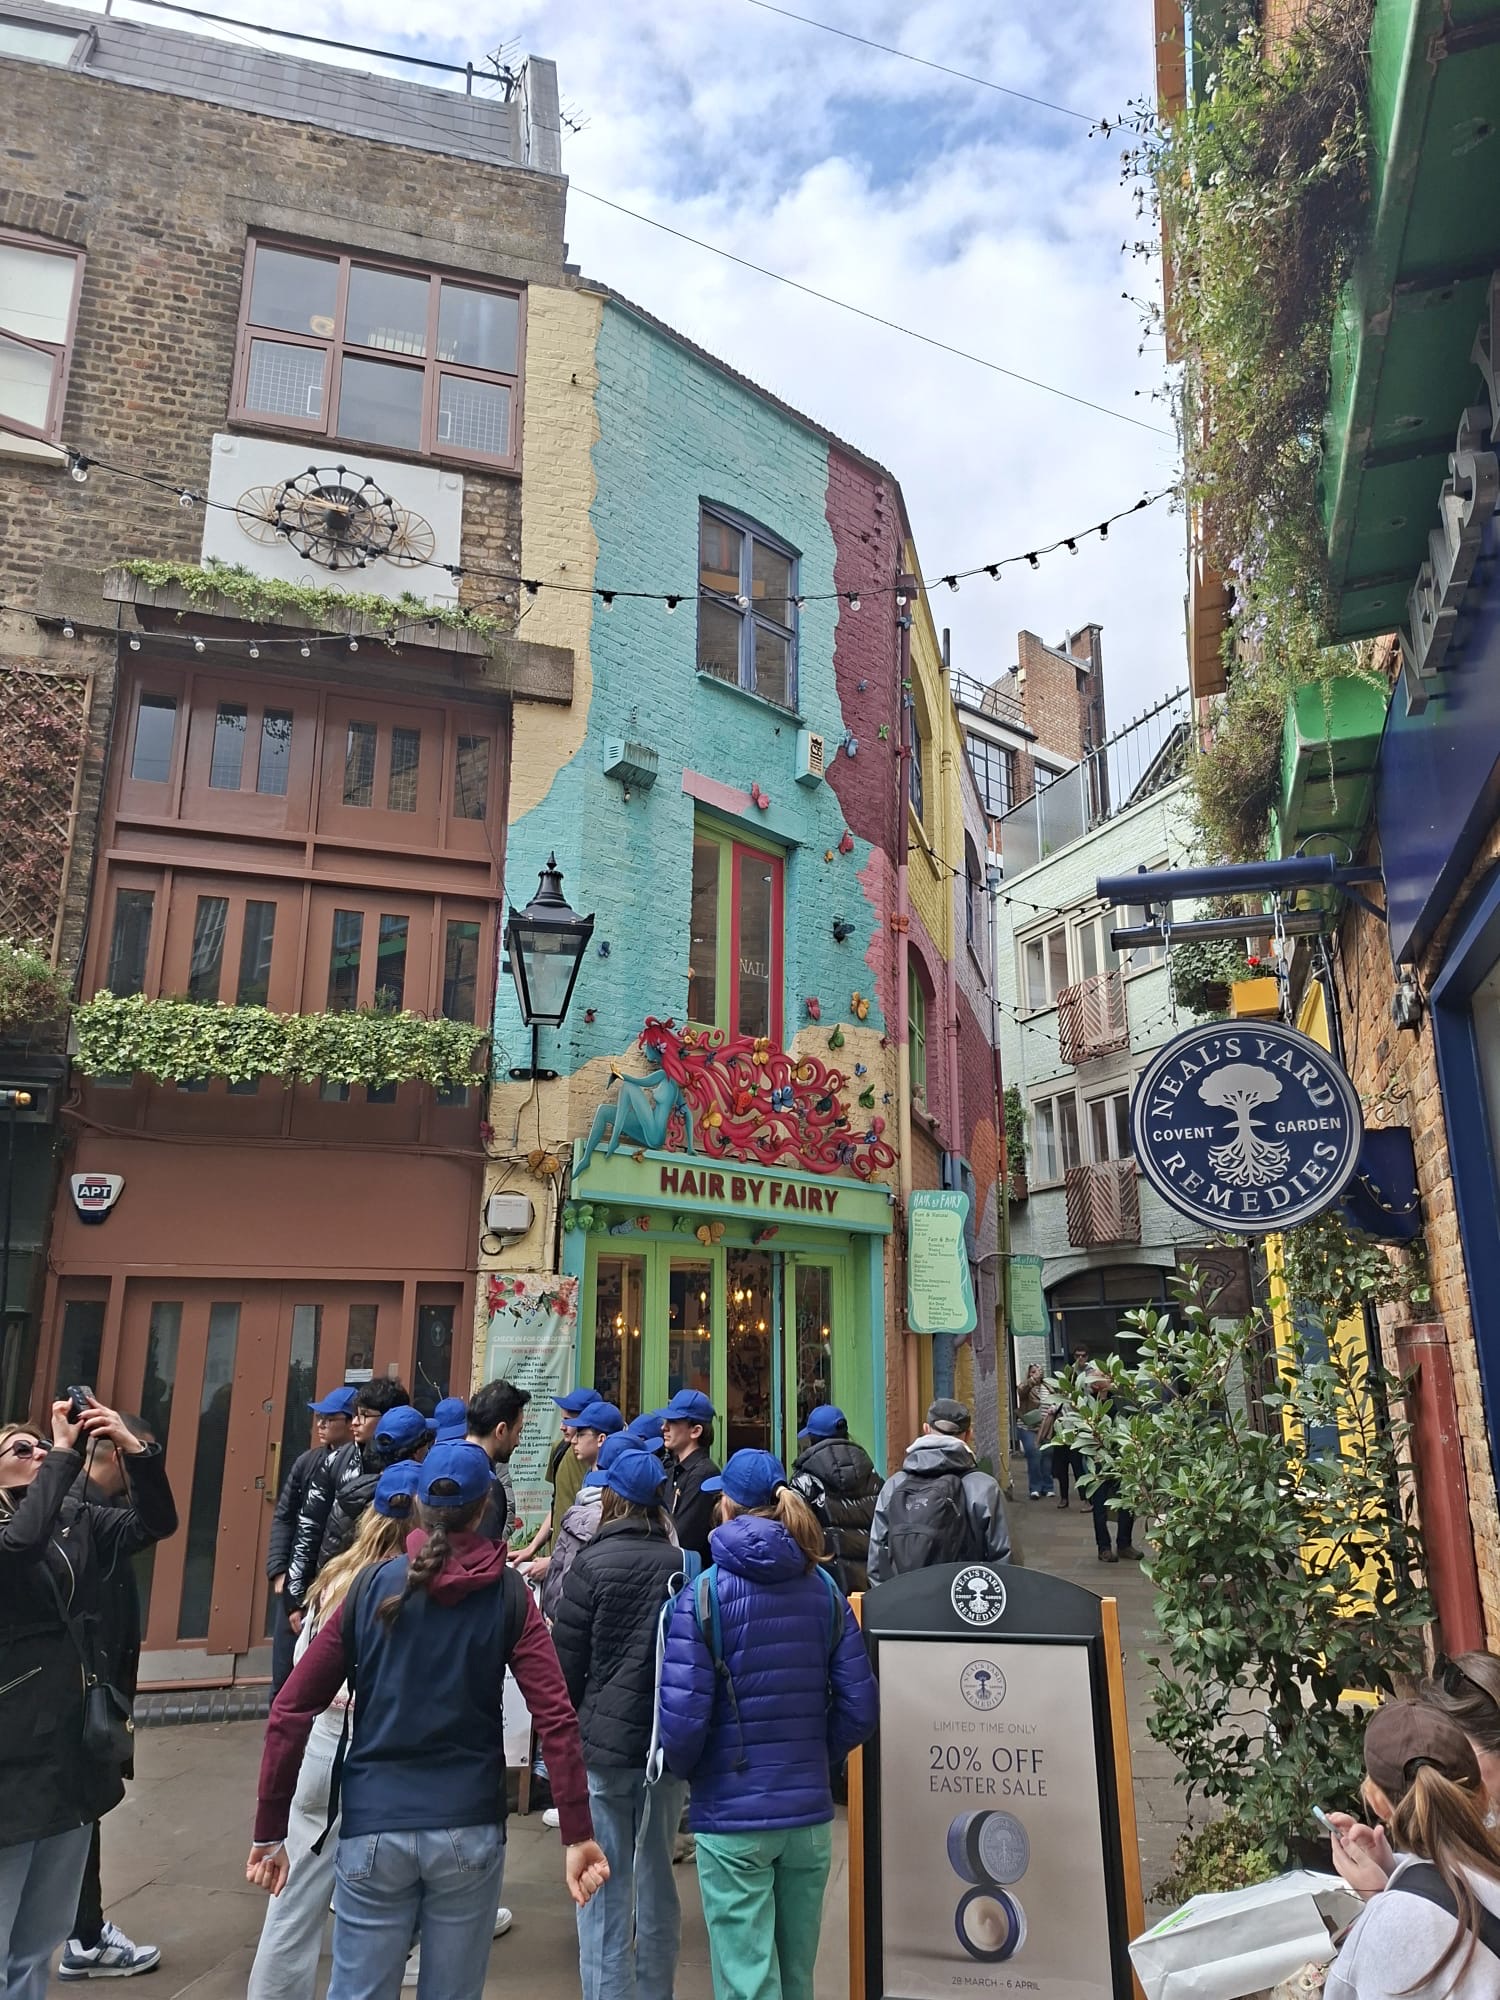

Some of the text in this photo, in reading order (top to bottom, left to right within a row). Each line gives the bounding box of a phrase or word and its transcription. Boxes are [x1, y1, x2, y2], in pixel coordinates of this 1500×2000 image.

[1152, 1038, 1334, 1120] NEAL'S YARD
[1153, 1117, 1341, 1142] COVENT GARDEN
[1161, 1140, 1338, 1212] REMEDIES
[79, 1186, 111, 1197] APT
[660, 1166, 838, 1213] HAIR BY FAIRY
[955, 1570, 1001, 1593] NEAL'S YARD
[957, 1601, 1001, 1621] REMEDIES
[933, 1720, 1038, 1735] LIMITED TIME ONLY
[930, 1745, 1044, 1773] 20% OFF
[930, 1775, 1048, 1796] EASTER SALE
[952, 1976, 962, 1985] 28
[964, 1977, 997, 1987] MARCH
[1006, 1979, 1012, 1988] 6
[1015, 1980, 1040, 1990] APRIL
